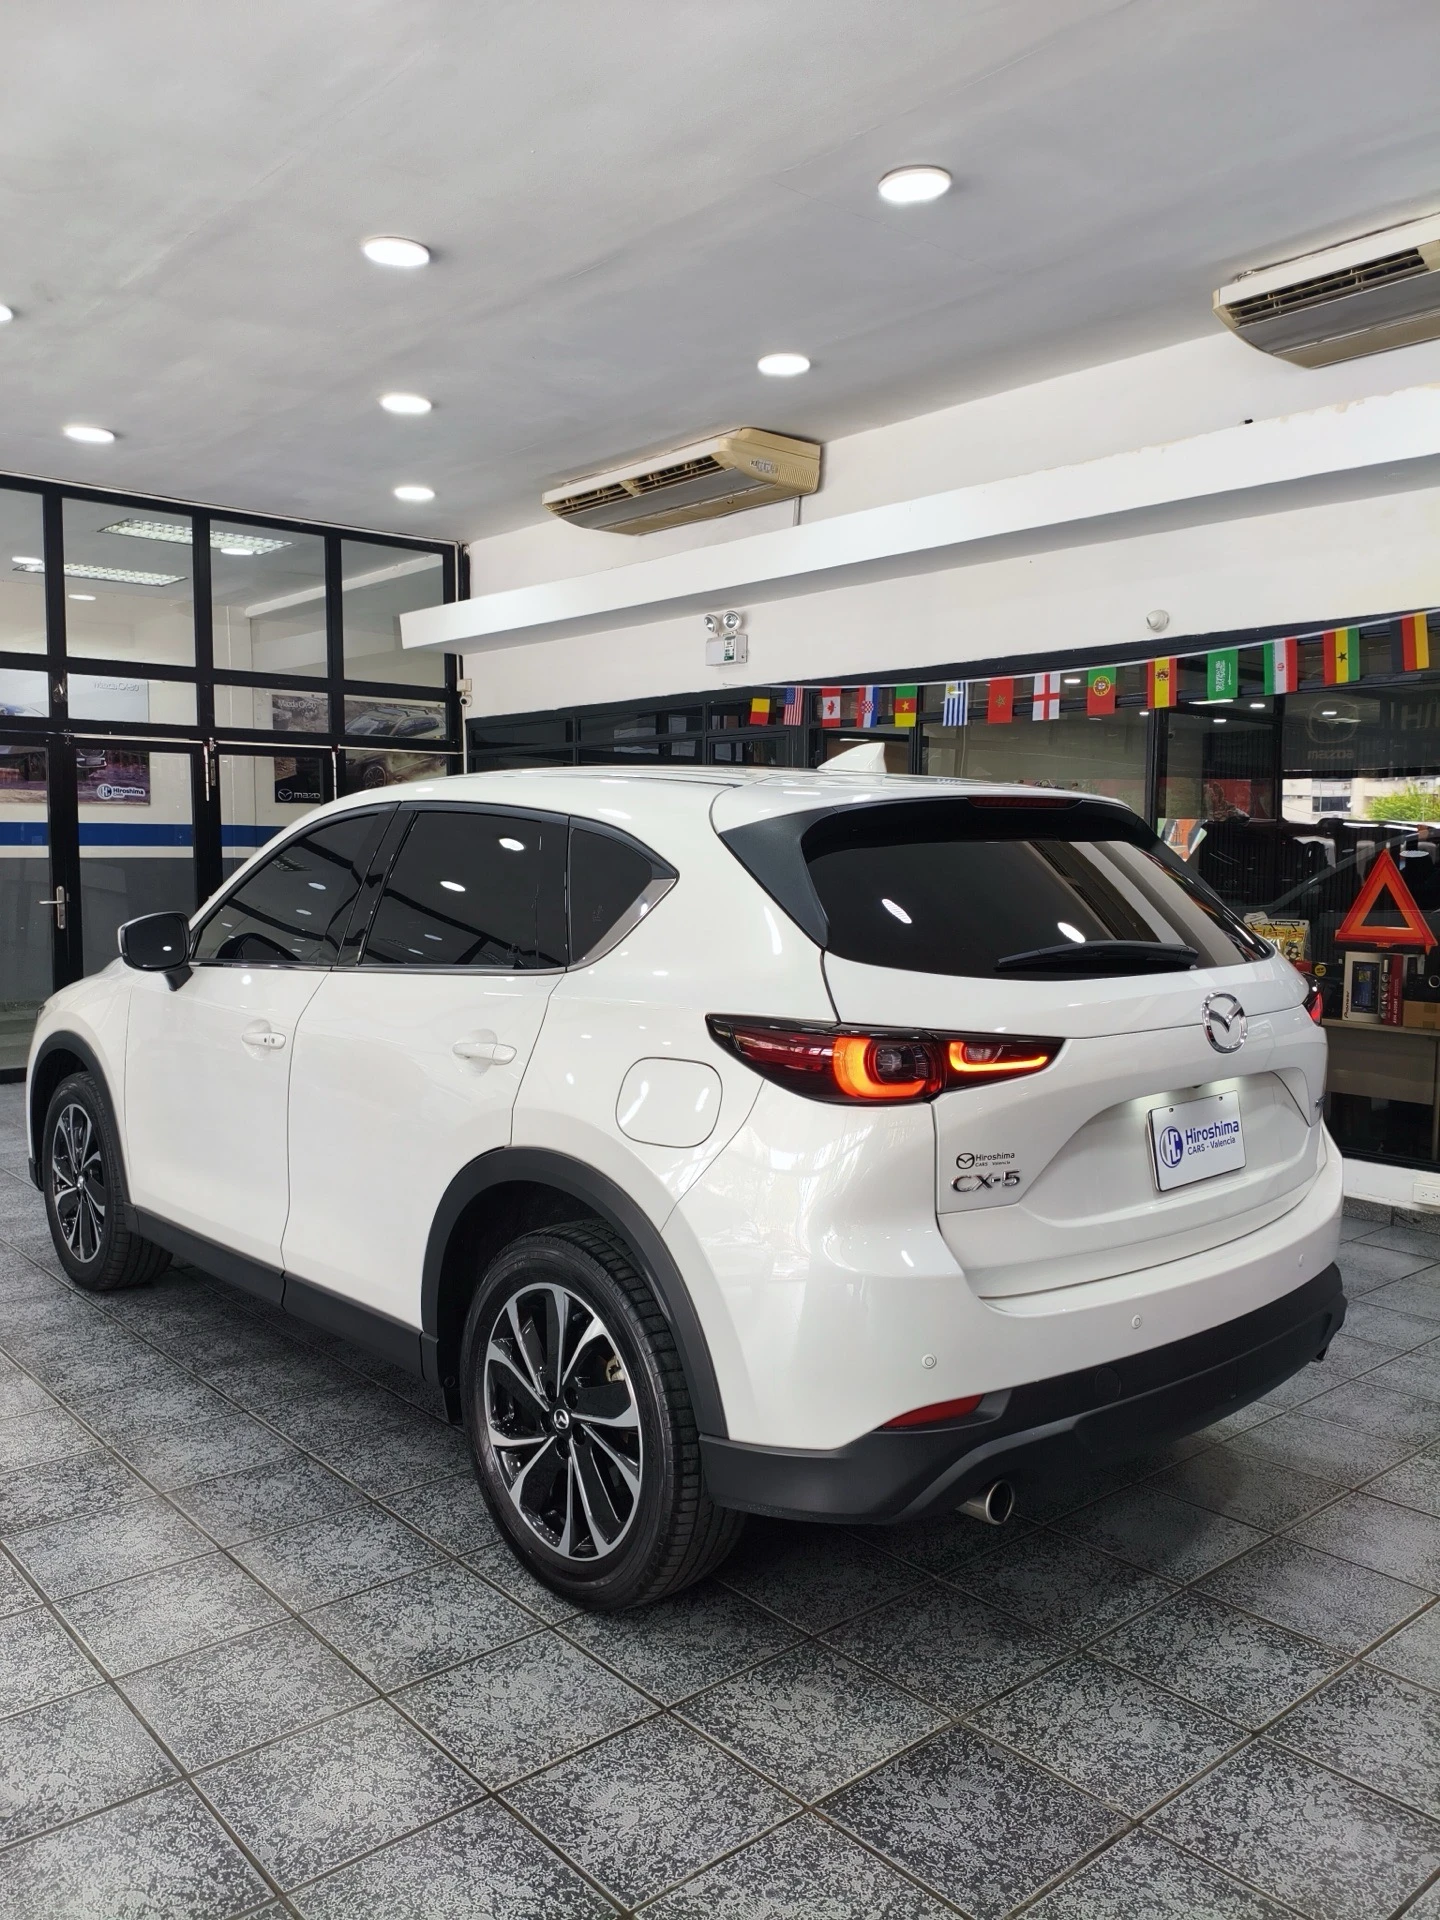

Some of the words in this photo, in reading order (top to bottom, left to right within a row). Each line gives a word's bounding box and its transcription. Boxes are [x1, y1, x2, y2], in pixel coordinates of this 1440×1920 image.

[112, 787, 144, 795] Hiroshima
[1185, 1120, 1240, 1145] Hiroshima
[1187, 1143, 1206, 1155] CARS
[1209, 1136, 1236, 1149] Valencia
[975, 1152, 1015, 1161] Hiroshima
[951, 1169, 1020, 1192] CX-5
